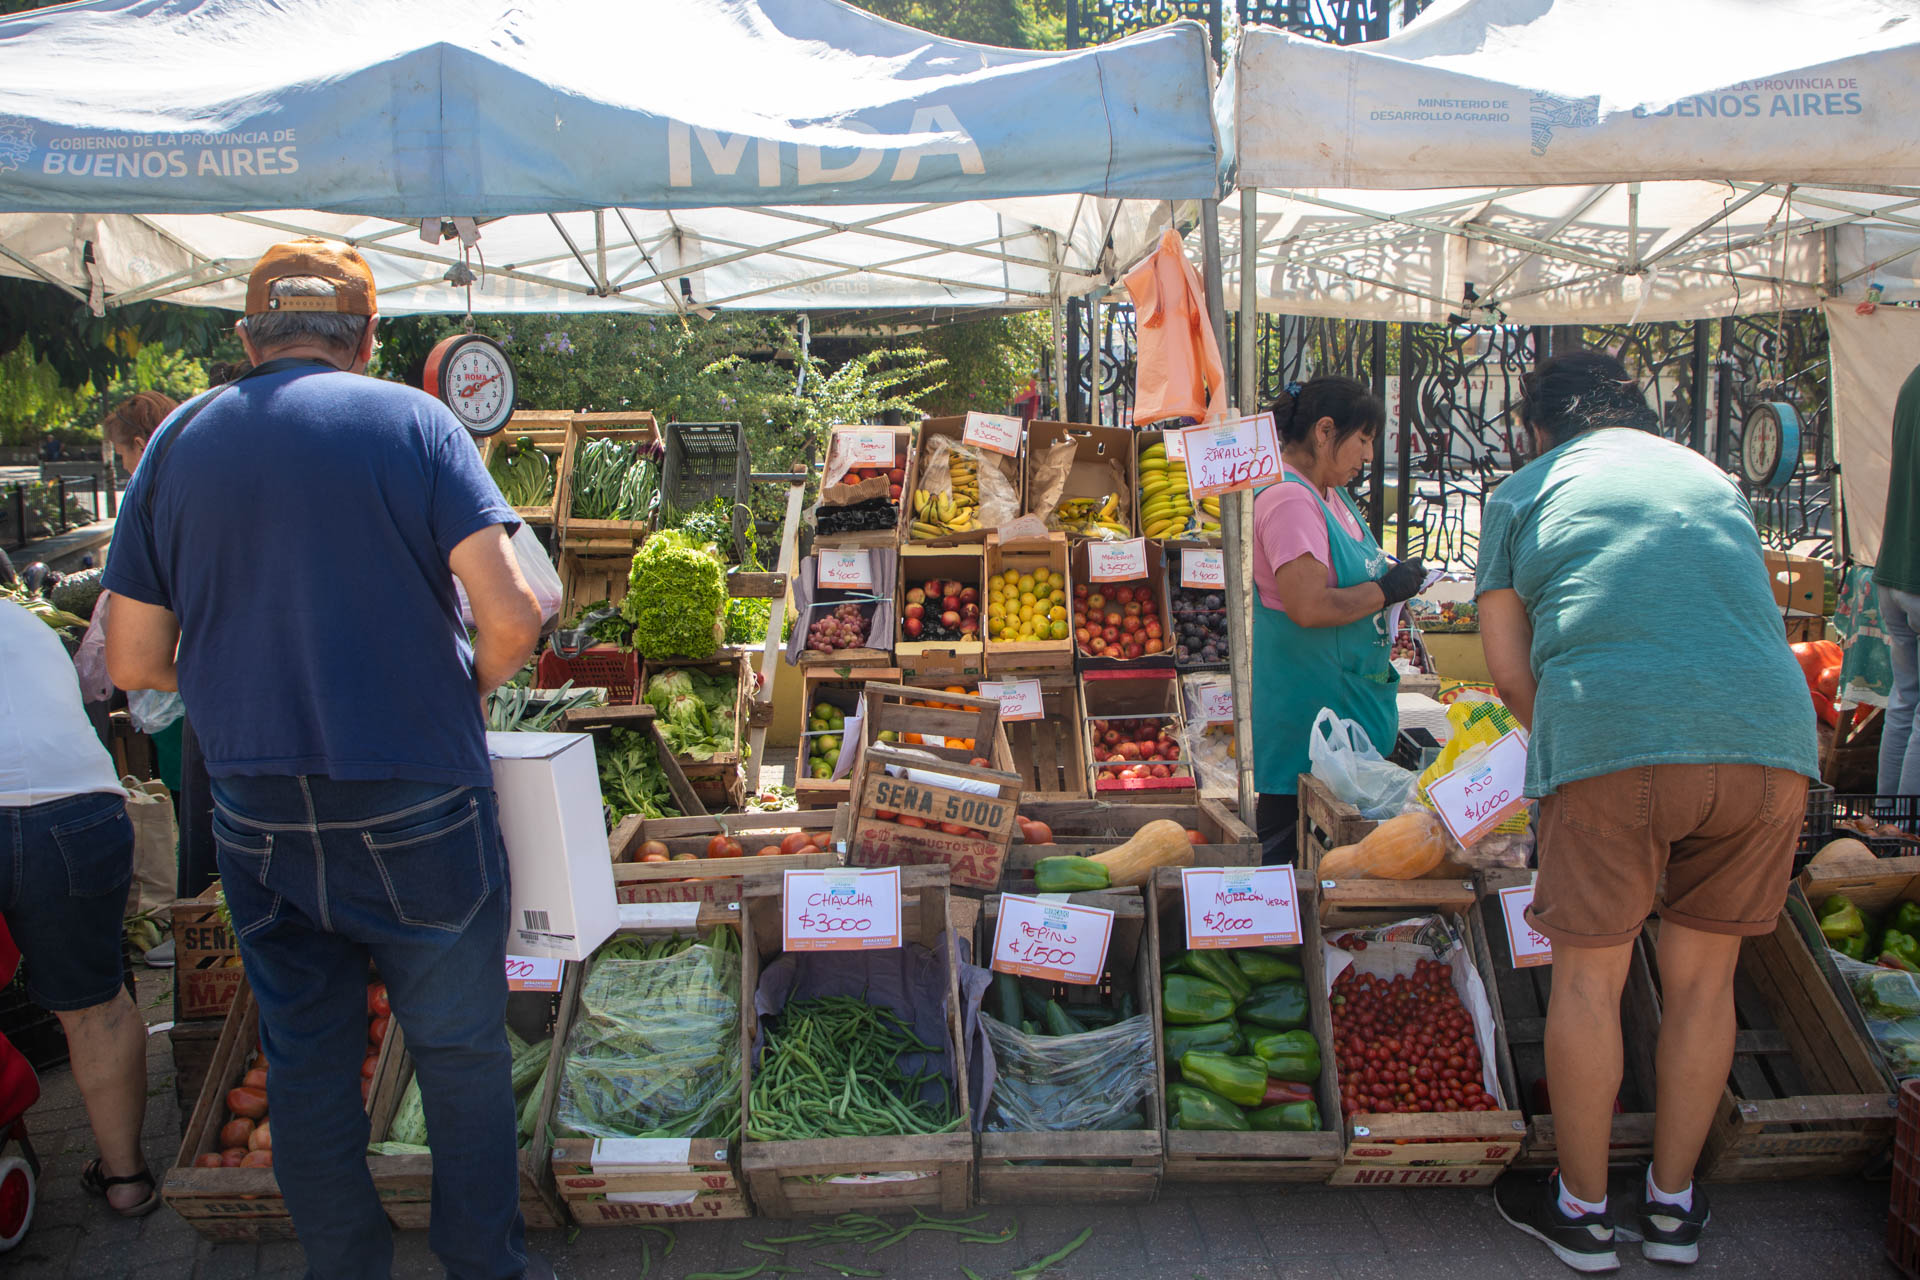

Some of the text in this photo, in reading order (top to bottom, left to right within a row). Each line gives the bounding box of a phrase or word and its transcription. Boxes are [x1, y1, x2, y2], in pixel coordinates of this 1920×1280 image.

[1754, 78, 1834, 91] PROVINCIA
[1838, 78, 1858, 90] DE
[1418, 98, 1510, 109] MINISTERIO DE
[1770, 92, 1863, 118] AIRES
[1370, 111, 1510, 122] DESARROLLO AGRARIO
[49, 128, 297, 150] GOBIERNO DE LA PROVINCIA DE
[668, 104, 986, 187] MDA
[43, 146, 299, 178] BUENOS AIRES
[473, 359, 479, 367] 0
[464, 373, 487, 381] ROMA
[475, 406, 480, 414] 5
[1000, 704, 1022, 715] 000
[1464, 775, 1493, 797] AJO
[945, 795, 1004, 828] 5000
[1464, 789, 1510, 821] $1000
[808, 892, 873, 908] CHAUCHA
[798, 907, 872, 933] $3000
[1203, 908, 1254, 933] $2000
[1354, 1169, 1480, 1184] NATALY
[599, 1200, 722, 1220] NATALY
